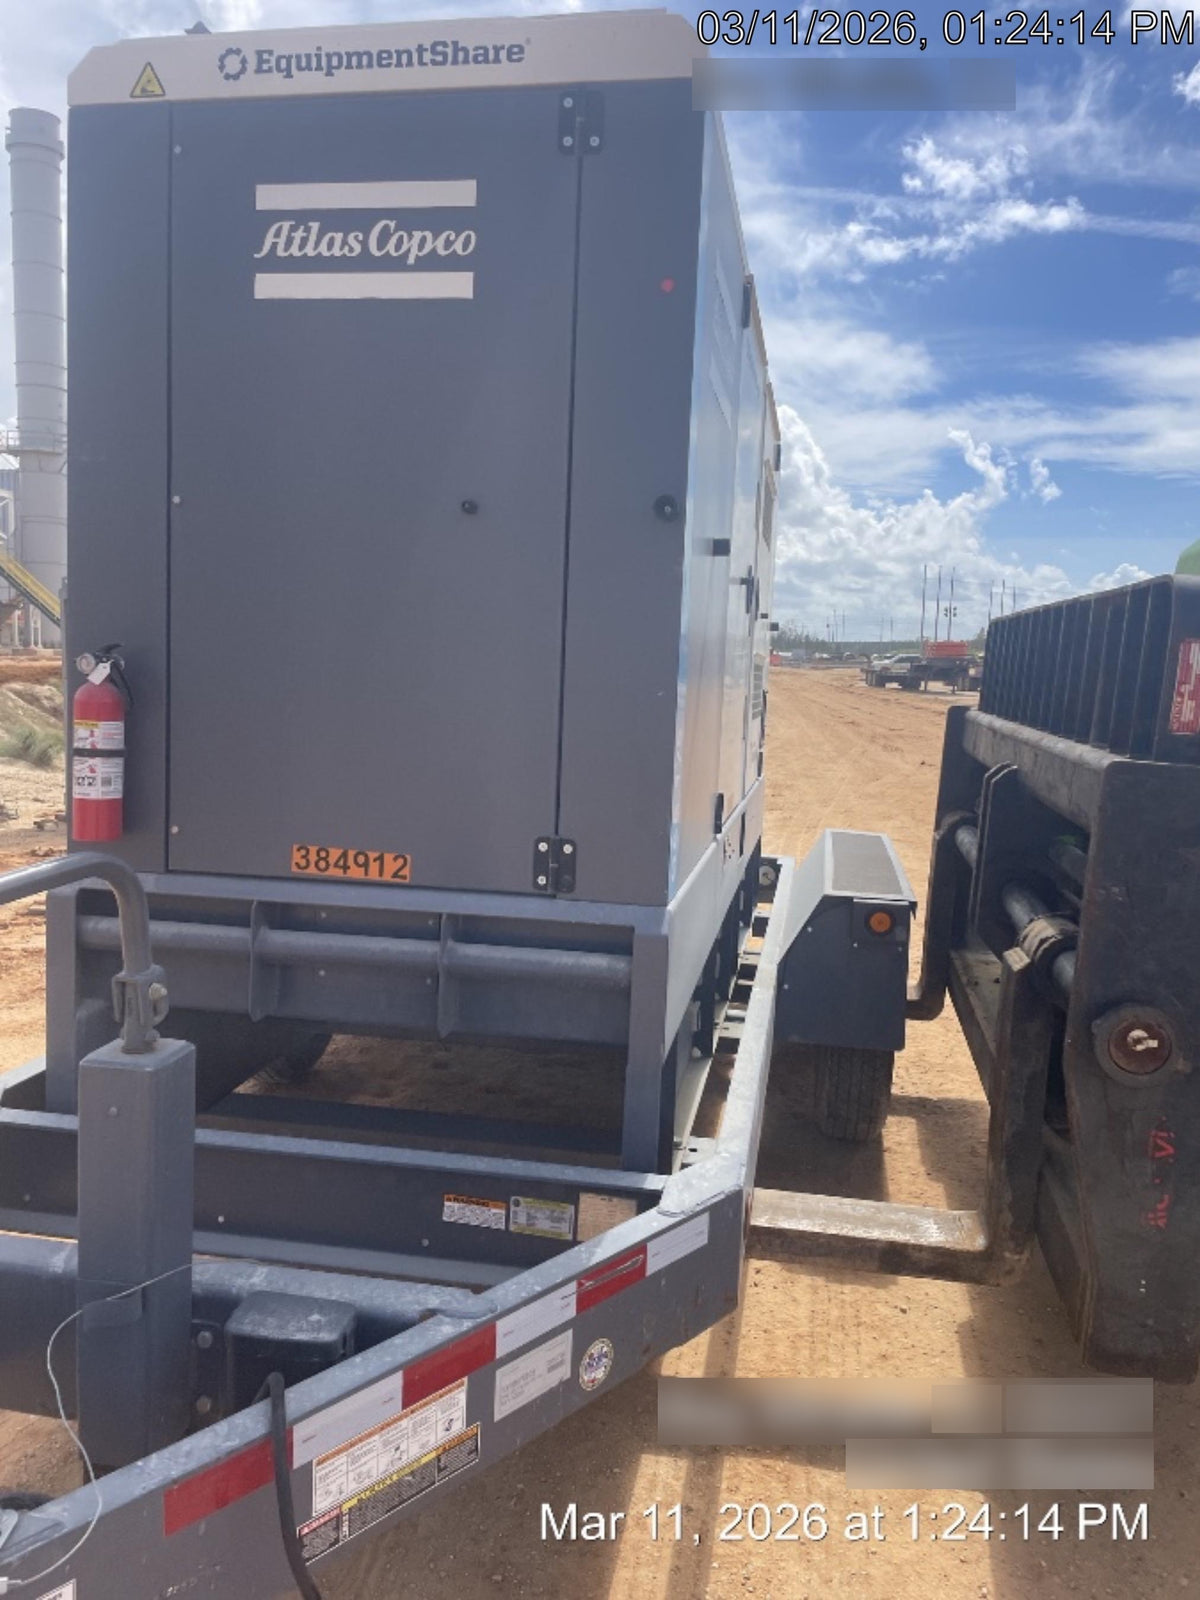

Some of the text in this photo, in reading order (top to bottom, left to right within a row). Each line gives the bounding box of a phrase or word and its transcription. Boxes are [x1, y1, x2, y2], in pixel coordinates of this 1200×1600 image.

[253, 40, 526, 78] EquipmentShare
[253, 219, 477, 265] Atlas Copco
[294, 845, 409, 881] 384912
